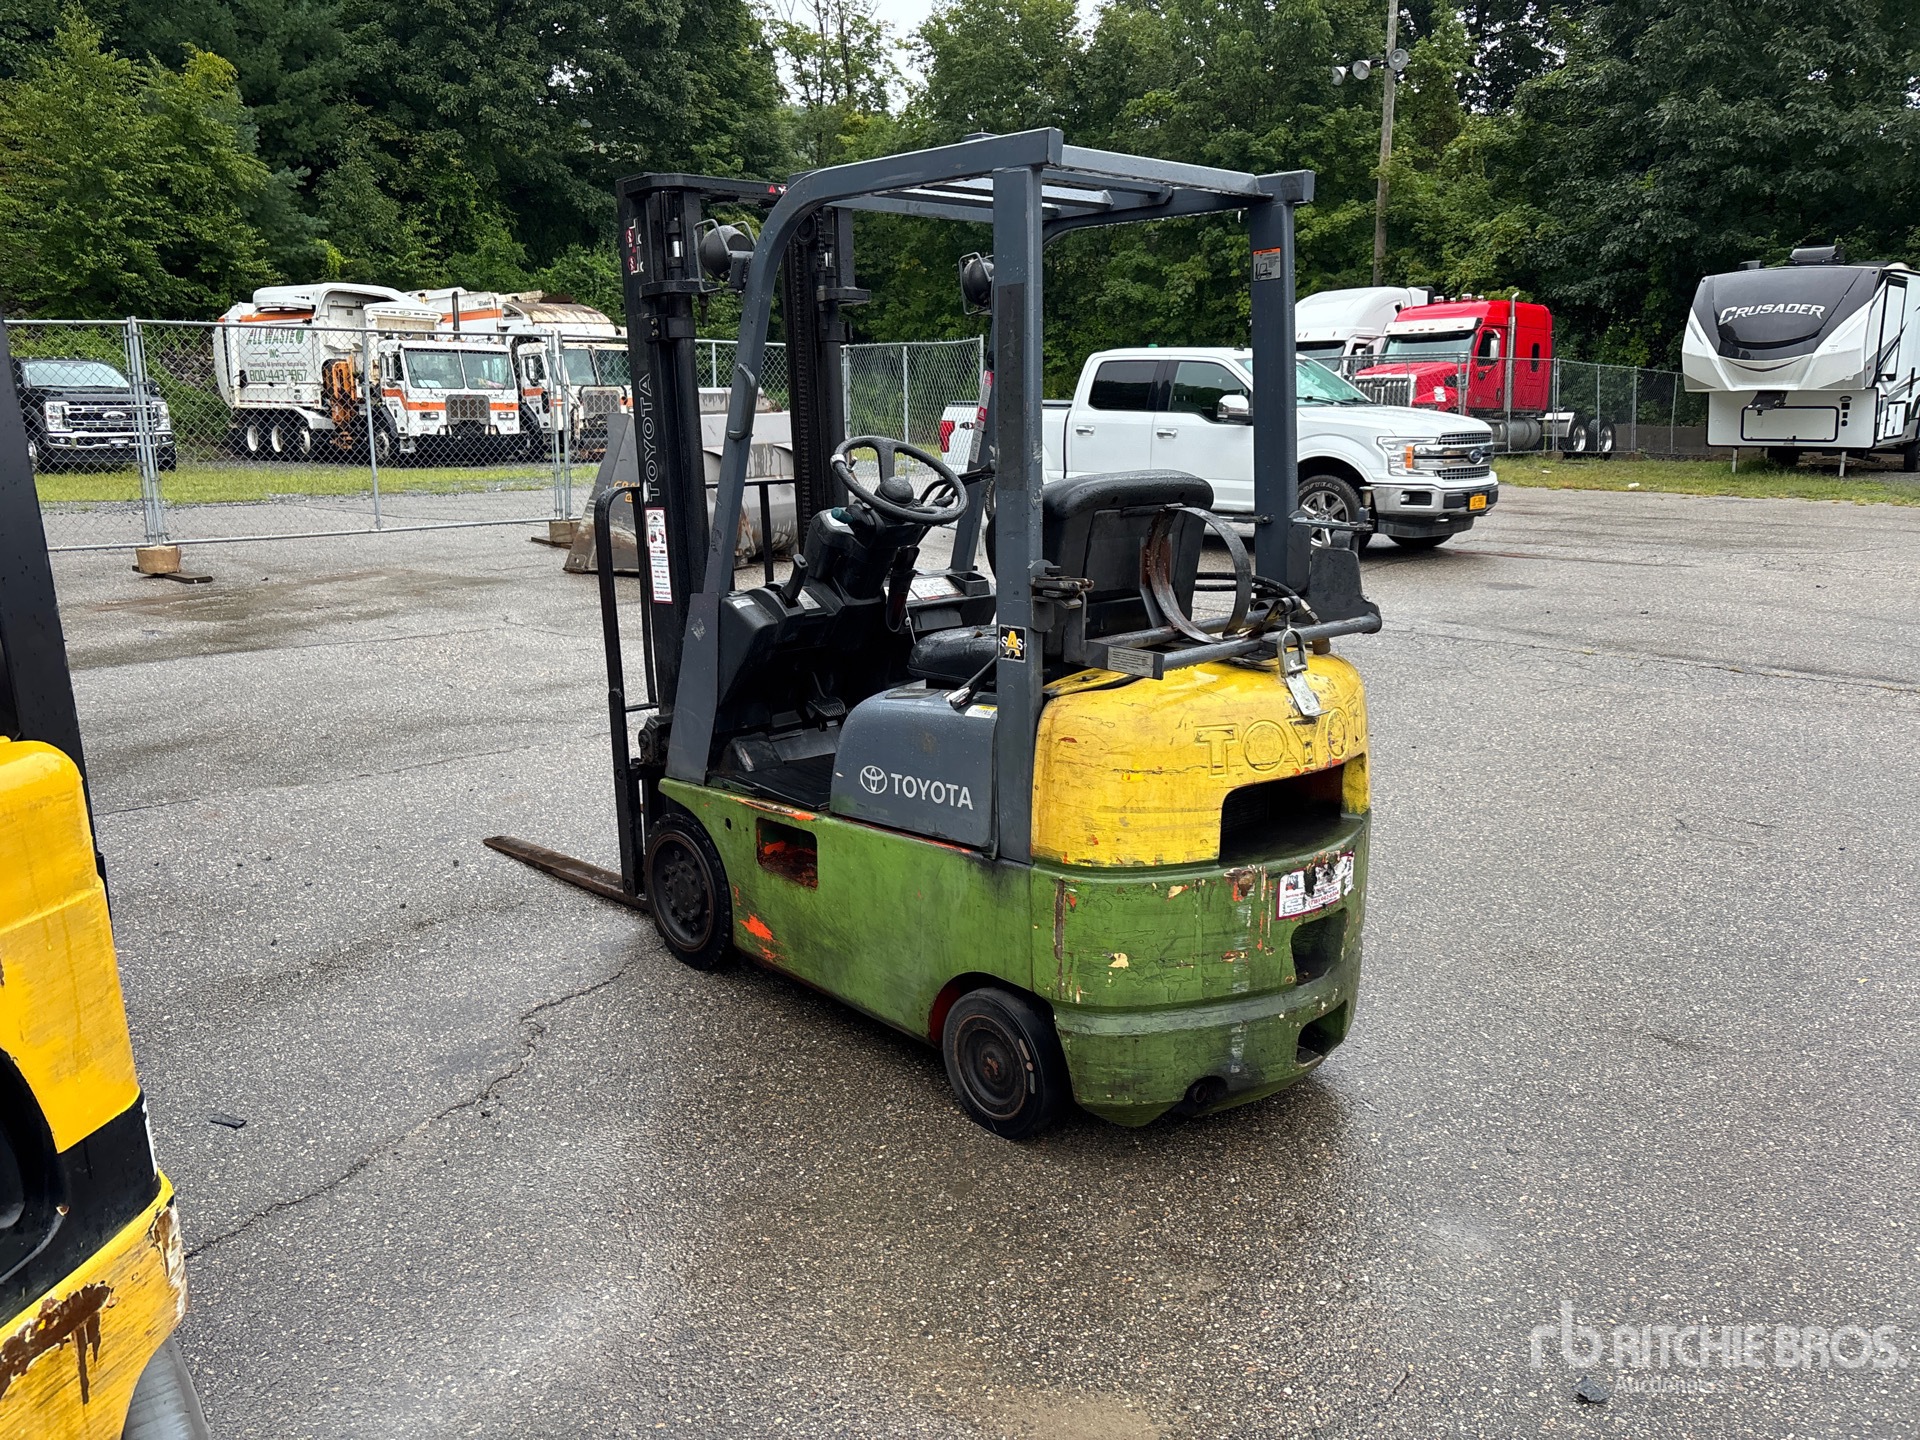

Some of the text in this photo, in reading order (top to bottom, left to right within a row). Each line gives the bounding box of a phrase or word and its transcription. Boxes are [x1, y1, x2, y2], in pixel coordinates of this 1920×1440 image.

[1718, 303, 1826, 326] CRUSADER
[265, 328, 295, 345] WASTE
[639, 372, 661, 502] TOYOTA
[890, 772, 974, 811] TOYOTA
